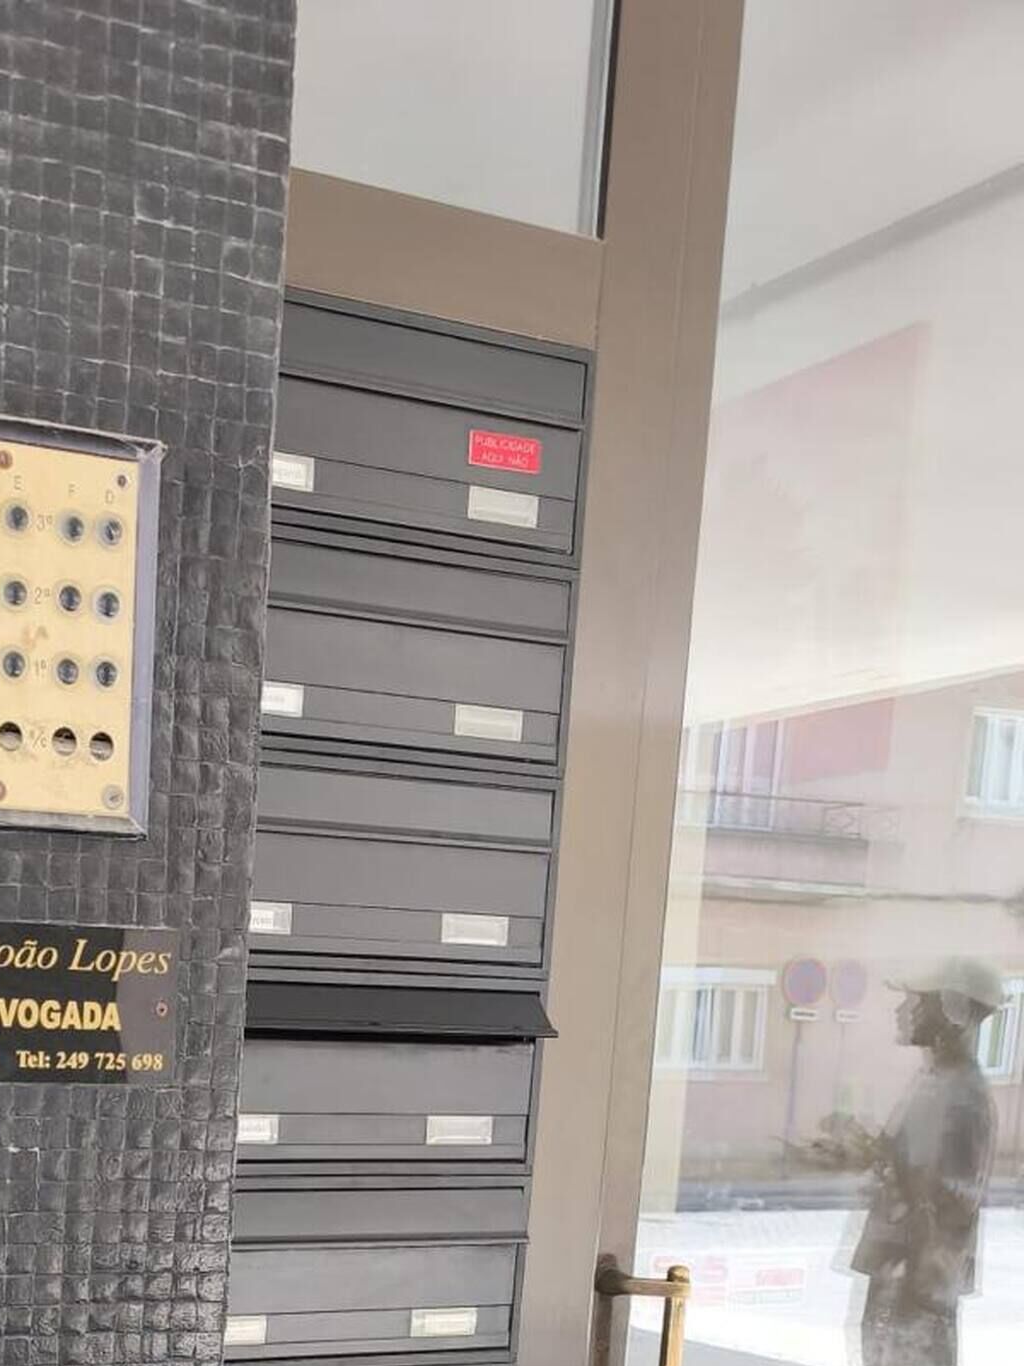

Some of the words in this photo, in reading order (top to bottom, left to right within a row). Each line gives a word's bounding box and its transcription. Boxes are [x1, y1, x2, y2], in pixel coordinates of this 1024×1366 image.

[67, 938, 171, 981] Lopes
[16, 1050, 51, 1069] Tel:
[55, 1052, 89, 1070] 249
[95, 1053, 126, 1071] 725
[131, 1053, 163, 1071] 698
